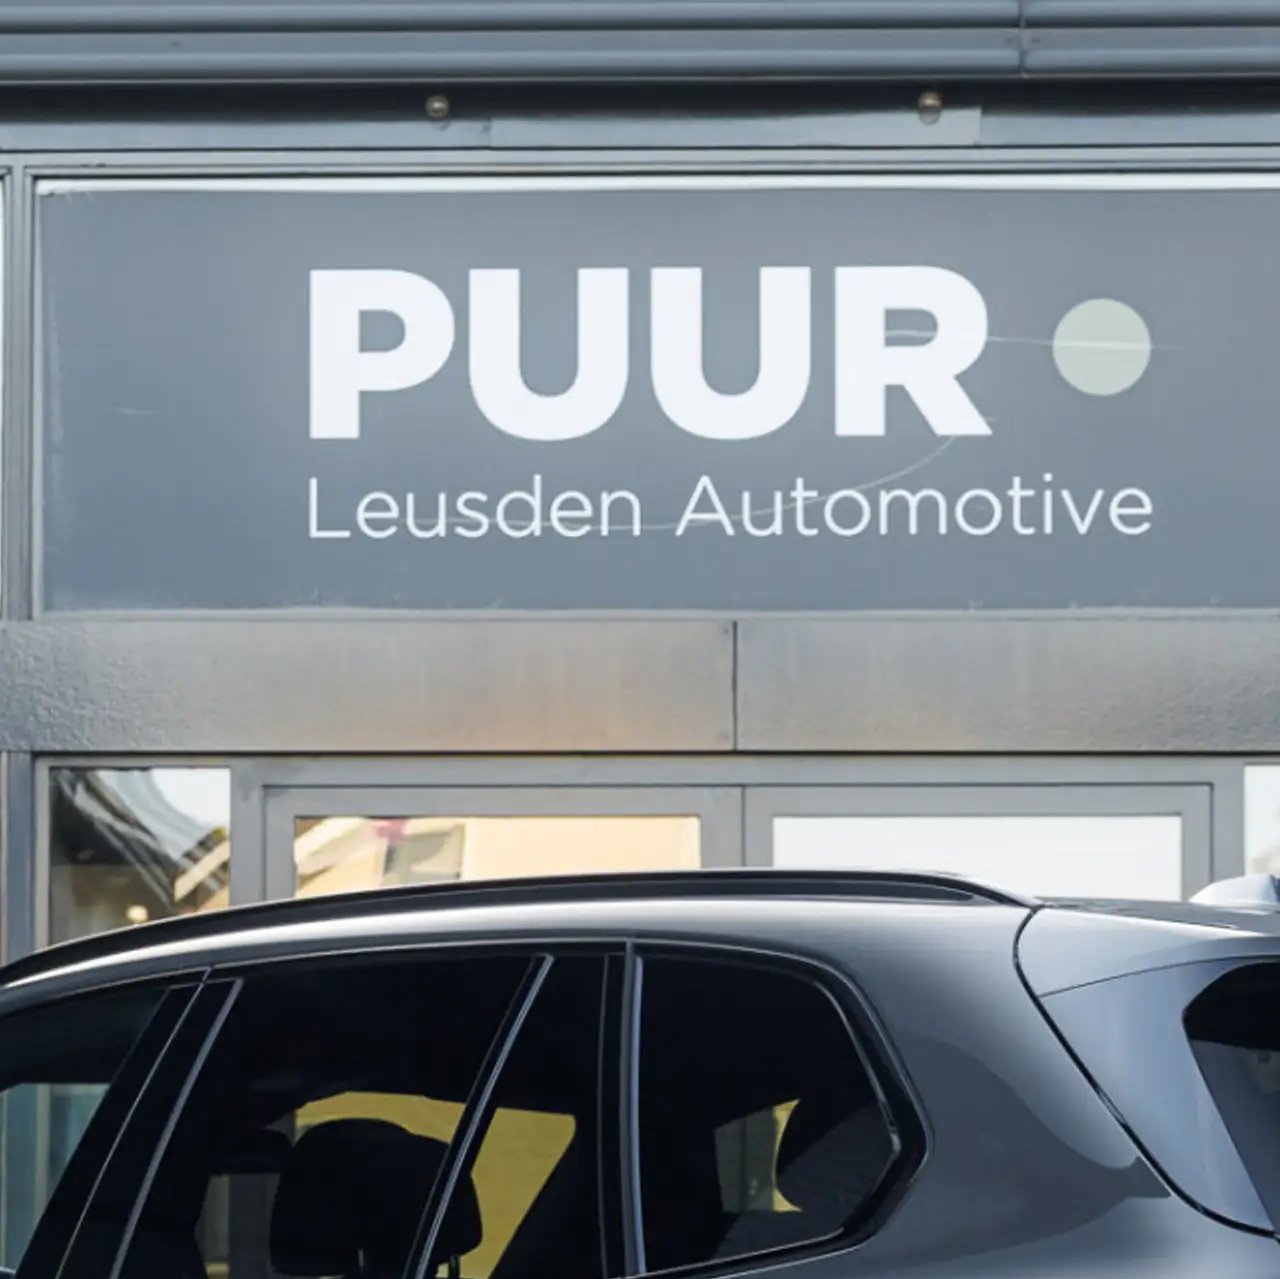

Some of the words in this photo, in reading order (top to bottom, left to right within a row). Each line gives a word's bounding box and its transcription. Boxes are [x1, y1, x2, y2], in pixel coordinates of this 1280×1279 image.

[309, 266, 992, 440] PUUR
[309, 474, 642, 538] Leusden
[674, 471, 1153, 538] Automotive
